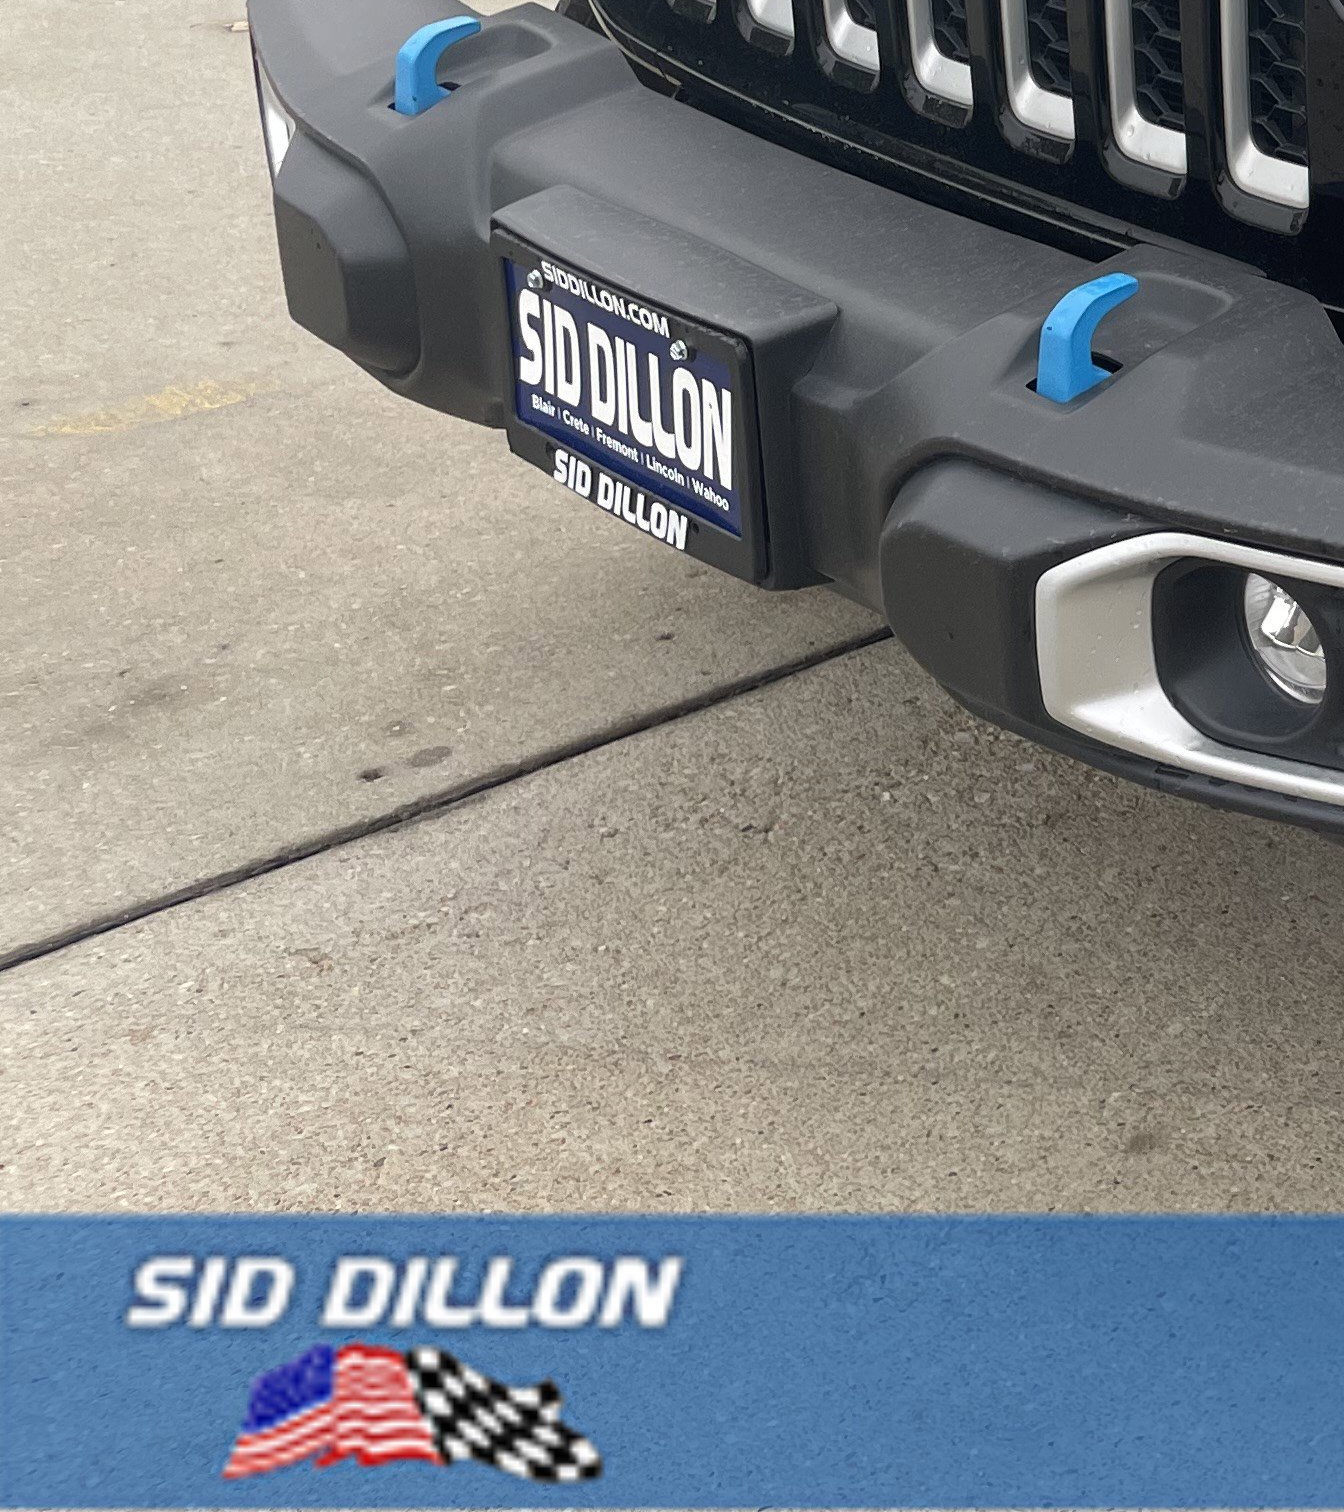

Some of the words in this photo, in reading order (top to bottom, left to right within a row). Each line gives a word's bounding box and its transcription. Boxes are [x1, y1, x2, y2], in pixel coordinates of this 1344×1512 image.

[540, 260, 670, 339] SIDDILLON.COM
[518, 288, 582, 407] SID
[586, 322, 733, 491] DILLON
[531, 394, 556, 419] Blair
[562, 408, 590, 436] Crete
[596, 427, 639, 464] Fremont
[645, 452, 685, 487] Lincoln
[691, 477, 730, 512] Wahoo
[553, 448, 591, 499] SID
[596, 472, 688, 551] DILLON
